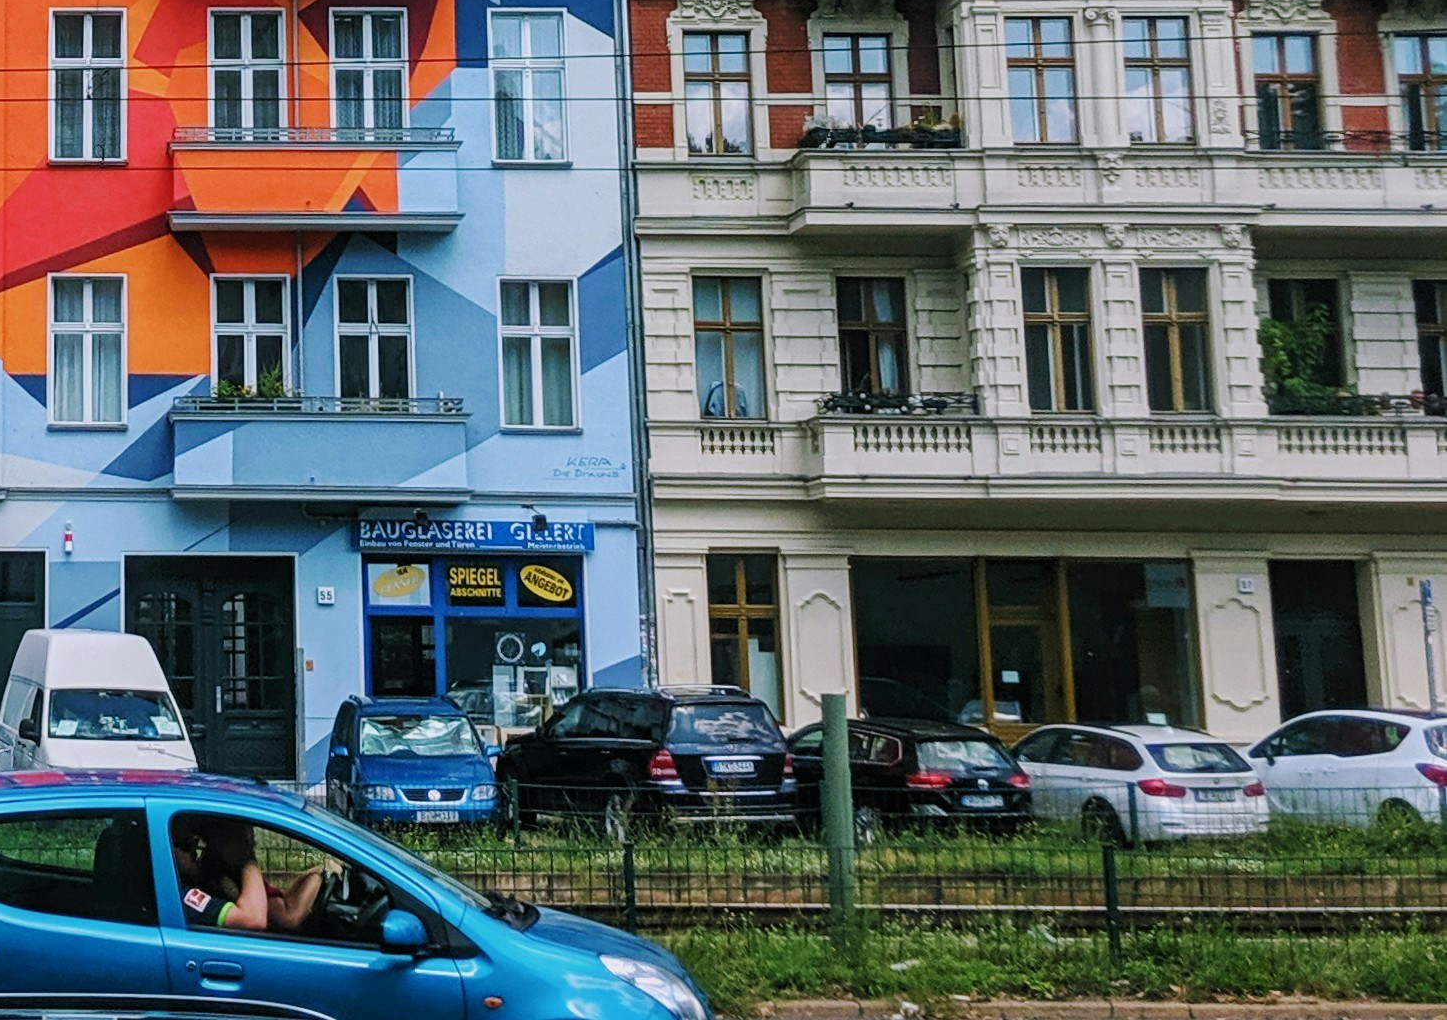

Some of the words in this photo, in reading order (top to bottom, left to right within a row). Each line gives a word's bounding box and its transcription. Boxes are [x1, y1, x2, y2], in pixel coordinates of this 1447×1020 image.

[566, 457, 612, 467] KERA
[360, 521, 493, 540] BAUGLASEREI
[403, 540, 434, 548] Fenster
[435, 540, 450, 548] und
[449, 567, 502, 586] SPIEGEL
[524, 571, 569, 599] ANGEBOT
[320, 591, 332, 601] 55
[450, 587, 502, 597] ABSCHNITTE
